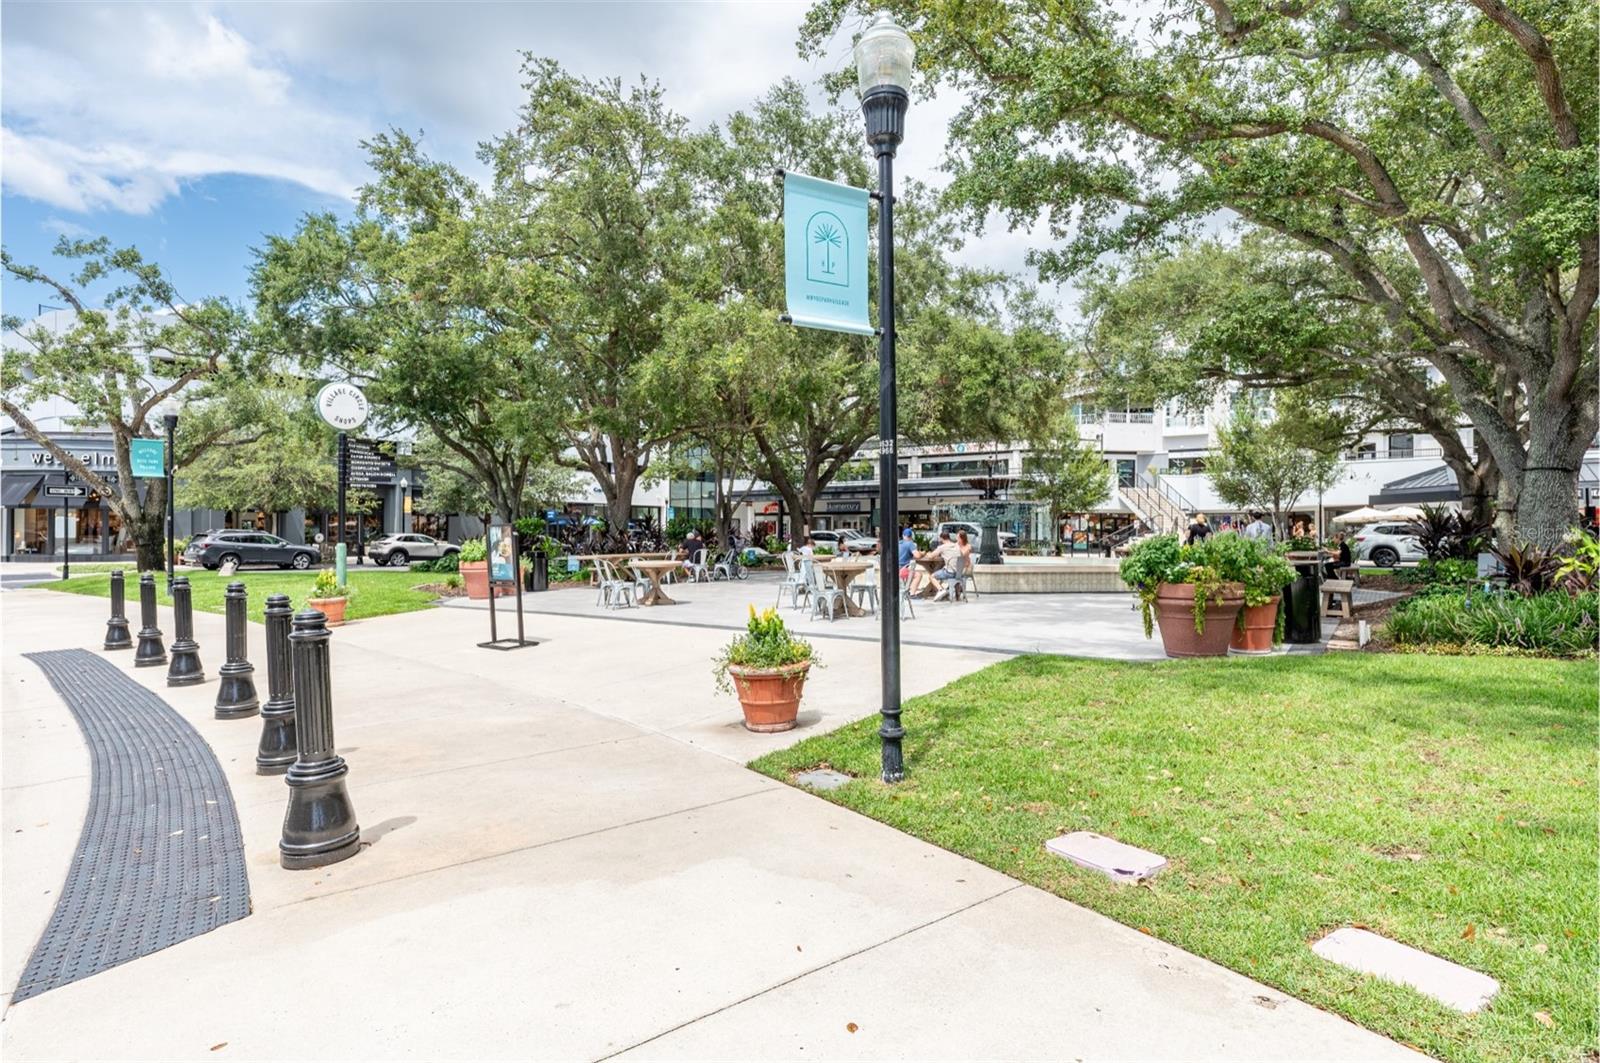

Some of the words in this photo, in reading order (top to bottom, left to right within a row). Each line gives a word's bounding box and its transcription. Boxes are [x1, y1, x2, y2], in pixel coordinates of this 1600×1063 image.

[326, 388, 347, 407] VILLAGE
[348, 390, 365, 411] CIRCLE
[334, 415, 357, 425] SHOPS
[31, 451, 73, 466] we
[81, 451, 116, 465] elm
